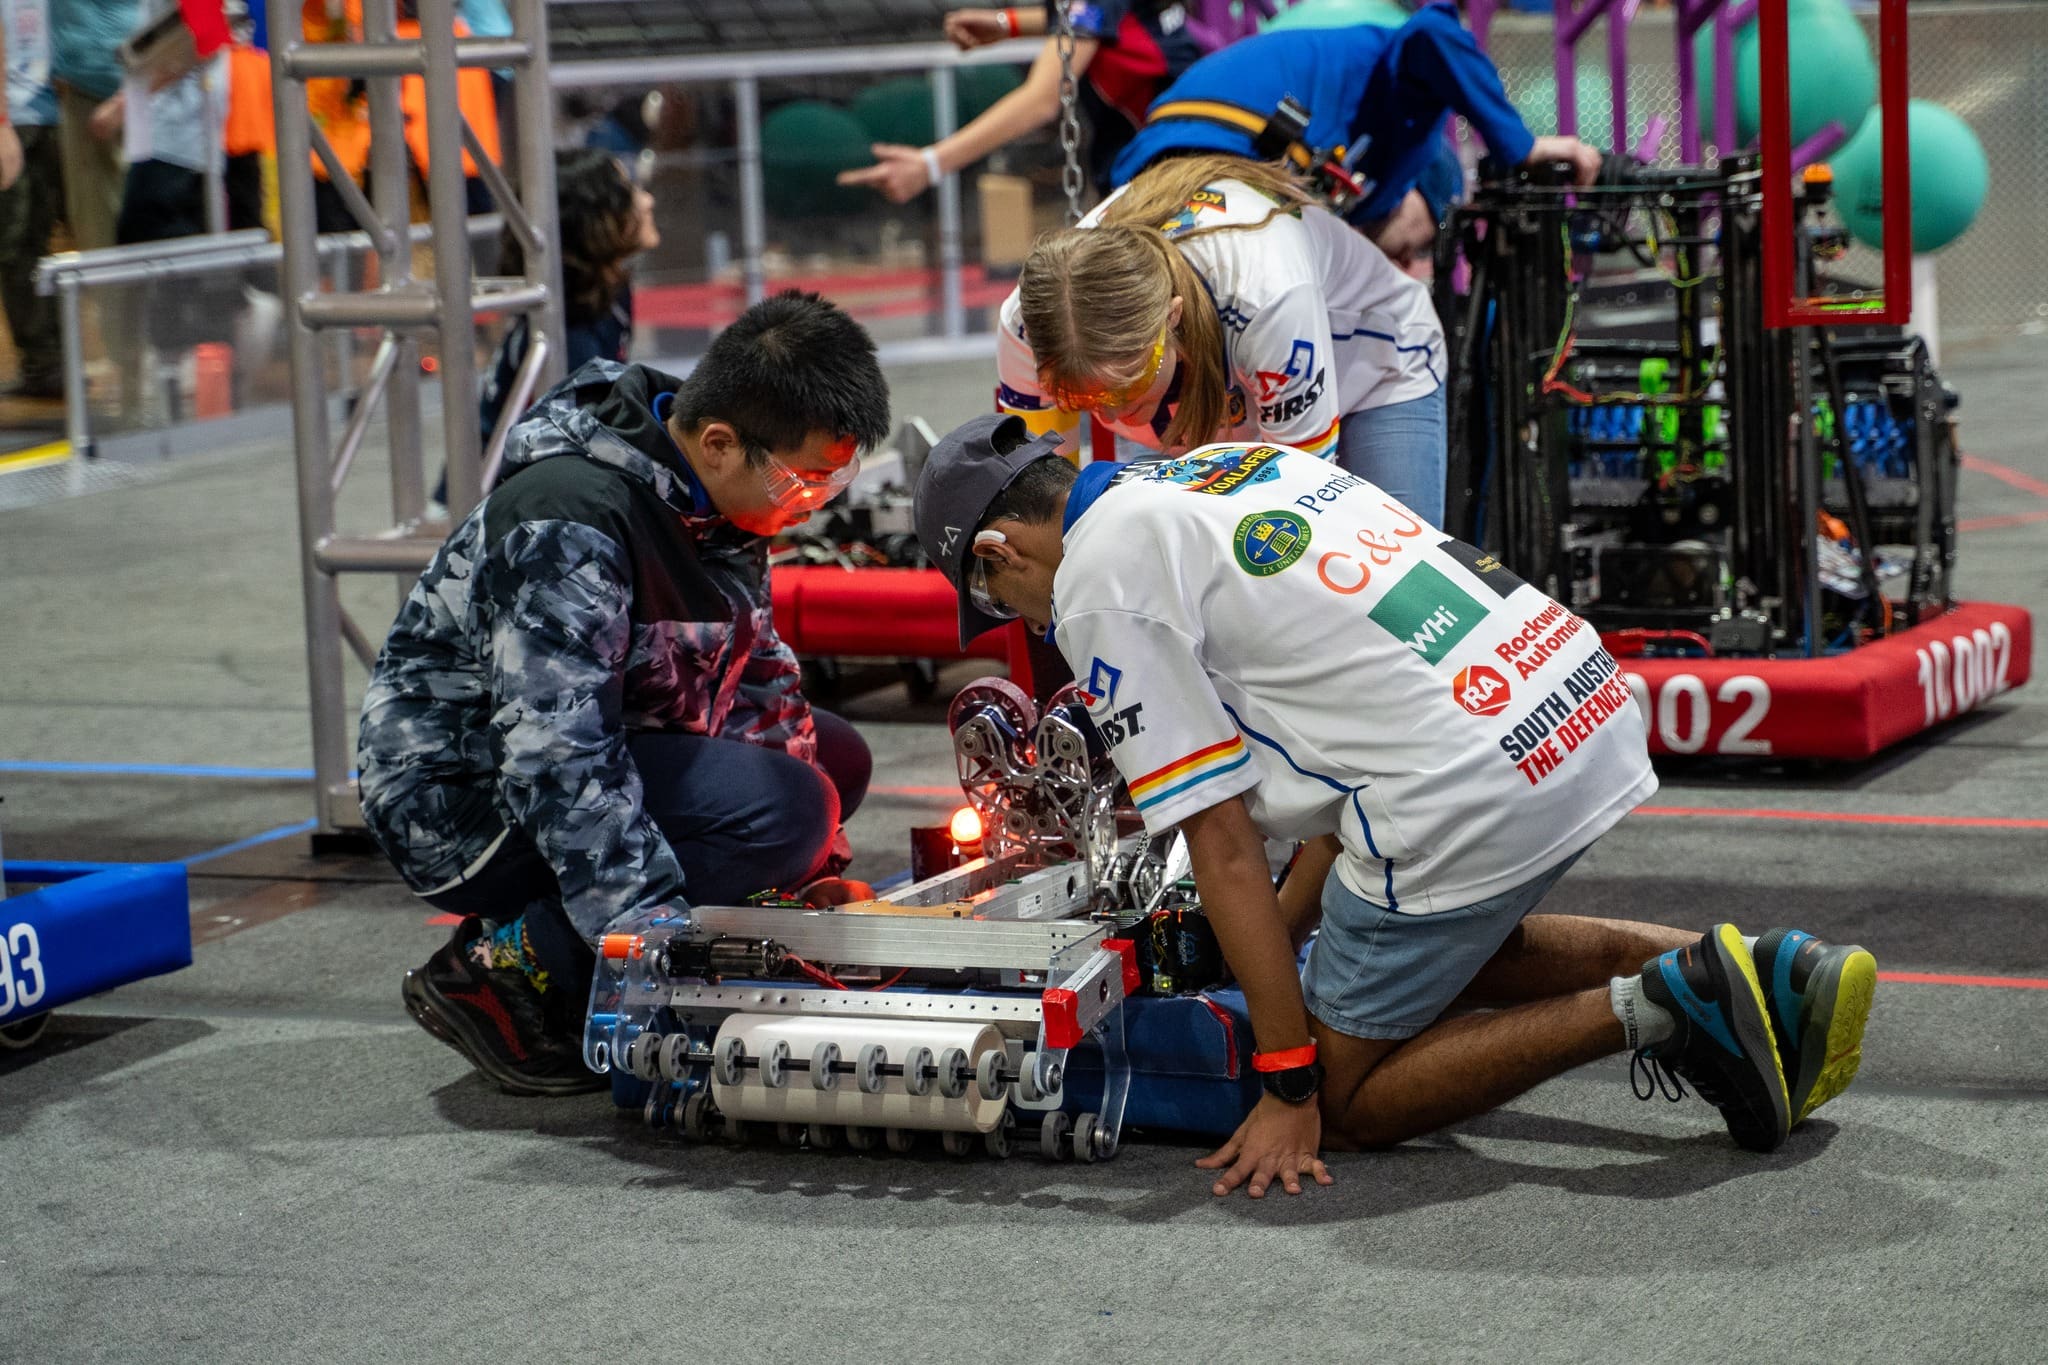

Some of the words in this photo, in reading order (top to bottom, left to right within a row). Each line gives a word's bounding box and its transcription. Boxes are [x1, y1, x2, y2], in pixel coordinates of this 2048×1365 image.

[1202, 446, 1278, 495] KOALAFIED
[1460, 675, 1504, 710] RA
[1500, 691, 1572, 762] SOUTH
[1516, 737, 1565, 787] THE
[1555, 677, 1627, 754] DEFENCE
